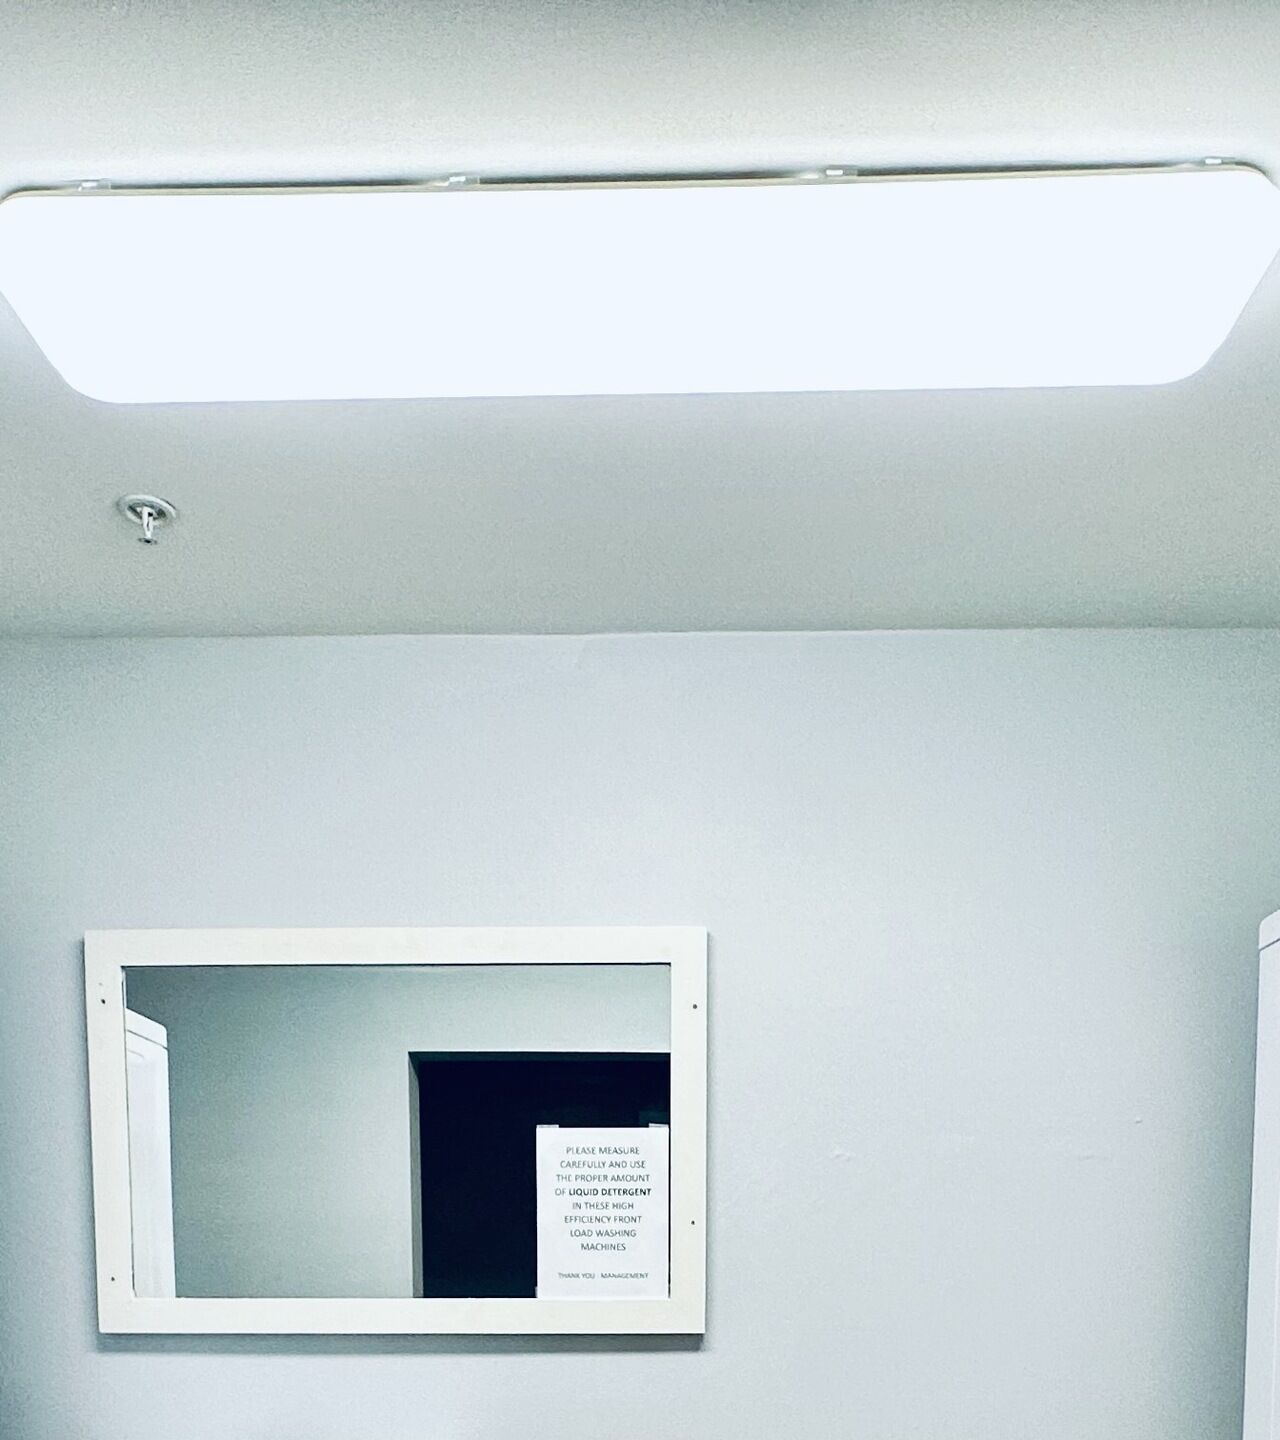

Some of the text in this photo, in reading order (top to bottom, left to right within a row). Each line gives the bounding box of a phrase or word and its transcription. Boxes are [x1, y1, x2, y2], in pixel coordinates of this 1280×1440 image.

[566, 1147, 640, 1155] PLEASE MEASURE
[560, 1161, 646, 1169] CAREFULLY AND USE
[556, 1174, 650, 1182] THE PROPER AMOUNT
[554, 1188, 652, 1196] OF LIQUID DETERGENT
[572, 1202, 634, 1210] IN THESE HIGH
[564, 1216, 642, 1224] EFFICIENCY FRONT
[570, 1229, 636, 1237] LOAD WASHING
[581, 1243, 626, 1251] MACHINES
